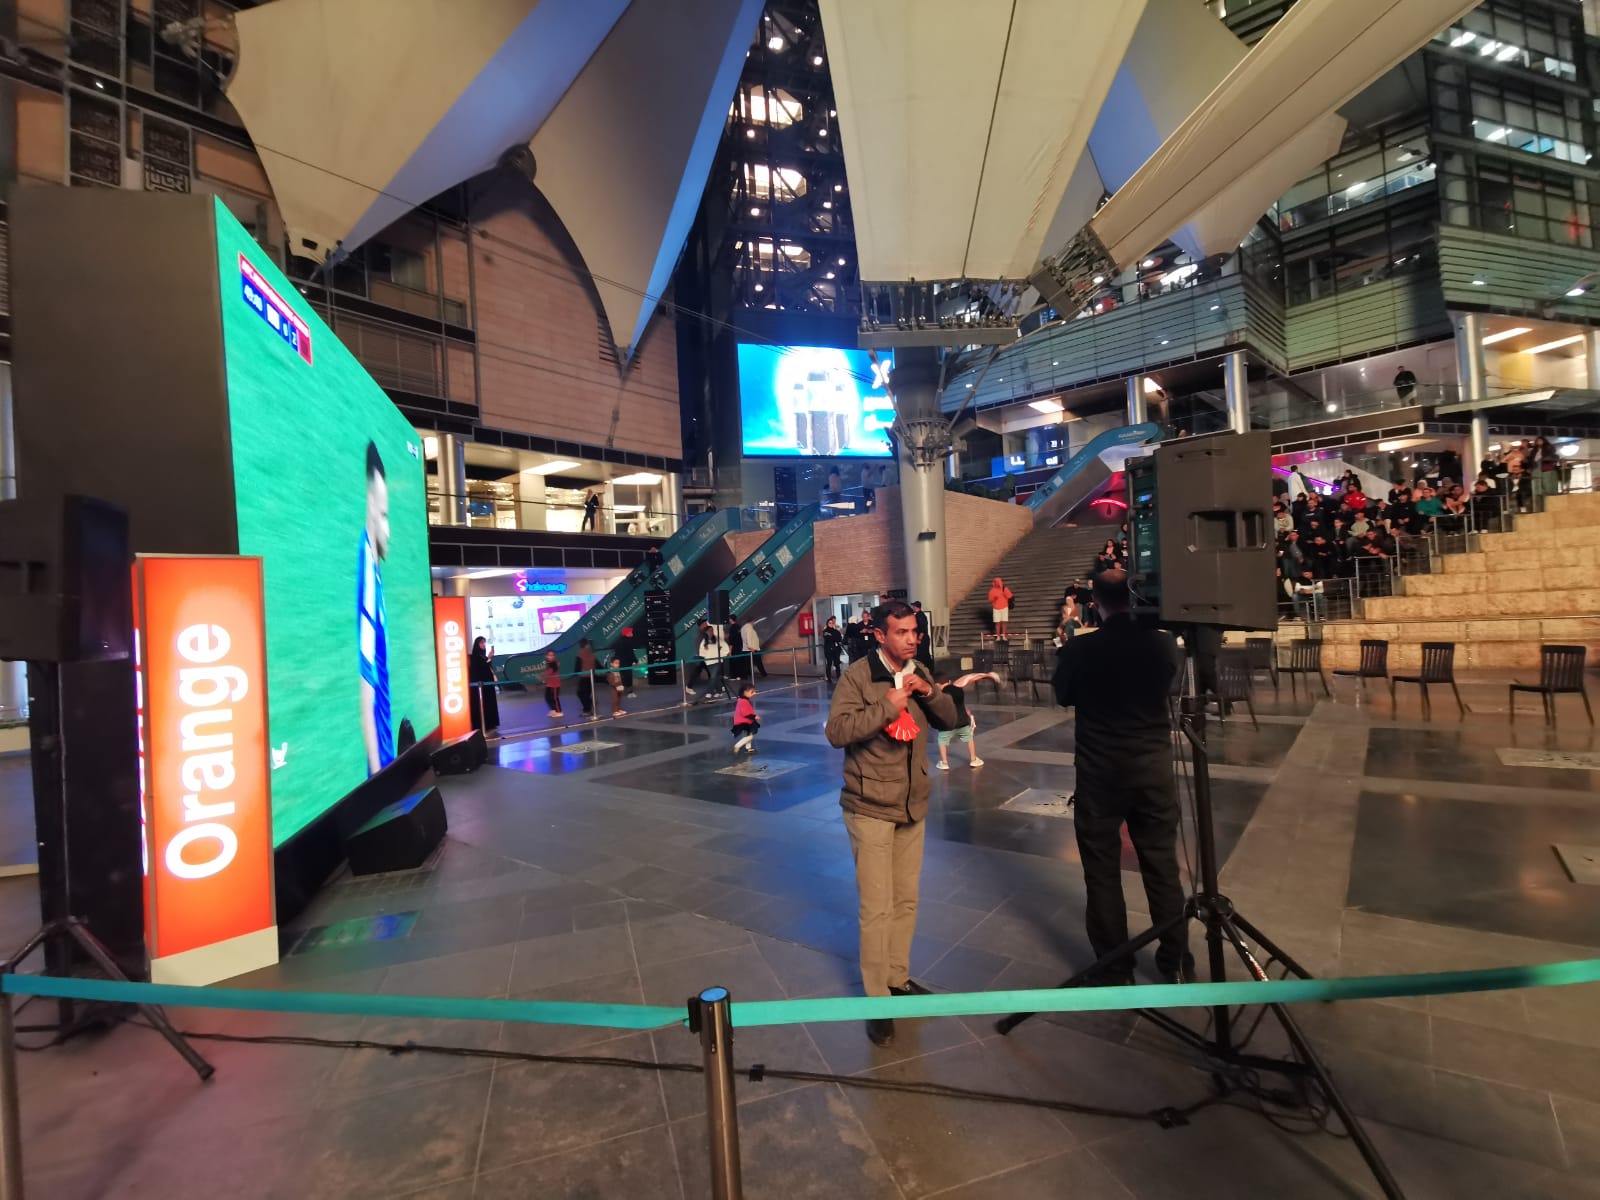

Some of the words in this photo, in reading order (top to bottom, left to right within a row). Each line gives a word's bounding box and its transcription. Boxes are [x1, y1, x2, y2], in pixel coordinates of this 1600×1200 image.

[591, 608, 605, 622] You
[602, 622, 615, 636] Are
[612, 611, 625, 624] You
[683, 618, 696, 631] Are
[443, 620, 465, 714] Orange
[165, 623, 249, 880] Orange
